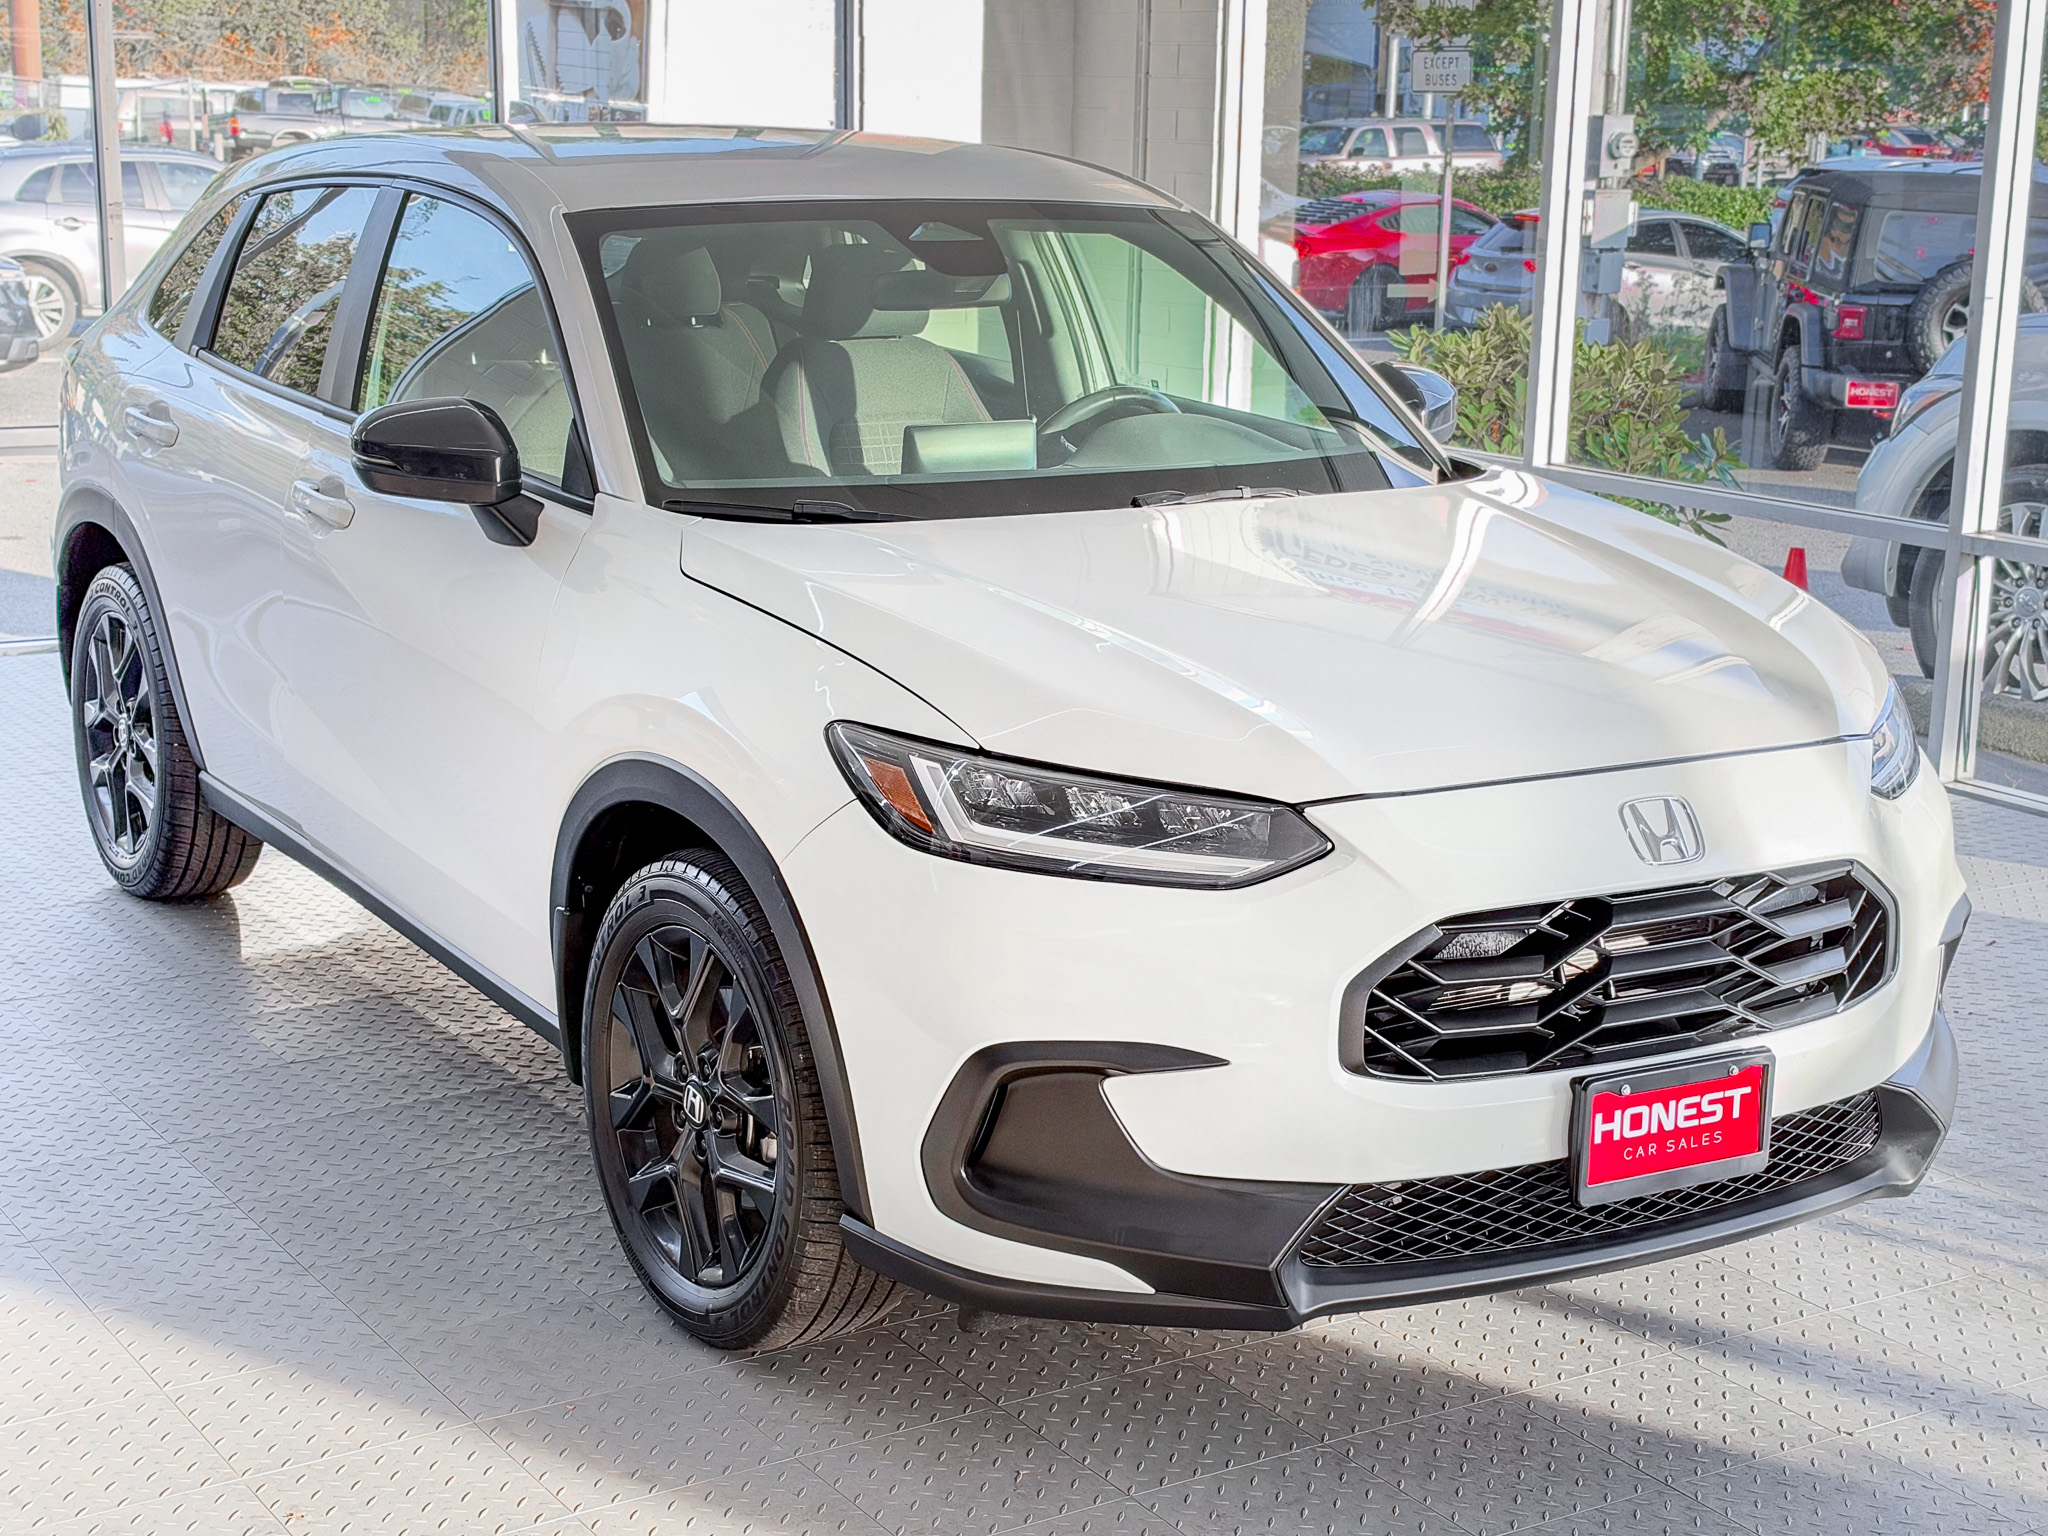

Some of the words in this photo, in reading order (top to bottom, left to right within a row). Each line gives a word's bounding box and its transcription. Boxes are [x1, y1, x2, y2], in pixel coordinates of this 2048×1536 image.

[1424, 57, 1460, 69] EXCEPT
[1425, 74, 1457, 86] BUSES
[1851, 388, 1893, 397] HONEST
[95, 582, 132, 617] CONTROL
[1594, 1086, 1751, 1144] HONEST
[781, 1097, 795, 1207] ROAD
[1624, 1143, 1656, 1160] CAR
[1666, 1131, 1723, 1152] SALES
